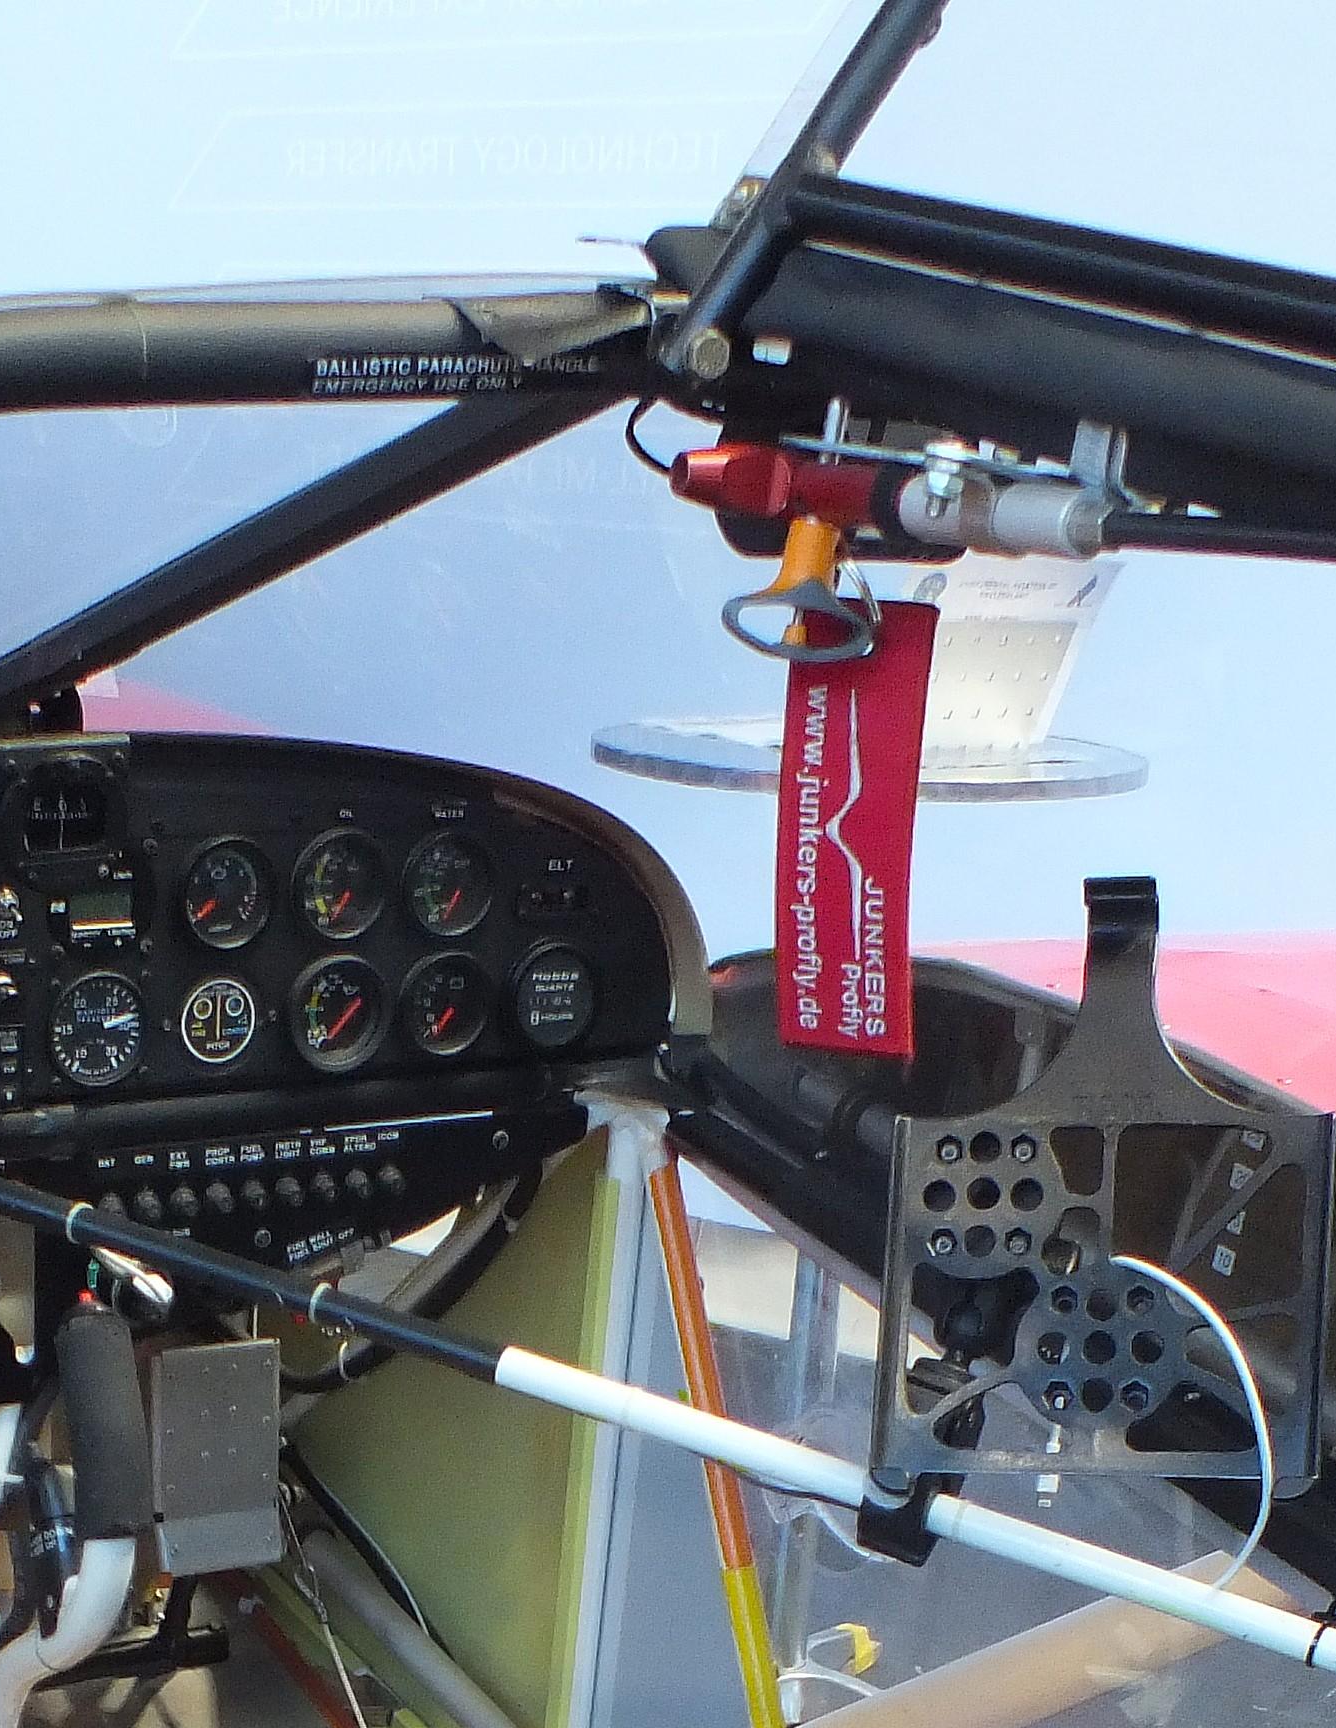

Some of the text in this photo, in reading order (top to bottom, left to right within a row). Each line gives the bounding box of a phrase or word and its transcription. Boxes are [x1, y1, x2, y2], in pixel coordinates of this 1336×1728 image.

[548, 859, 573, 871] ELT
[788, 685, 829, 1031] www.junkers-profly.de
[837, 963, 863, 1039] Profly
[864, 876, 887, 1036] JUNKERS
